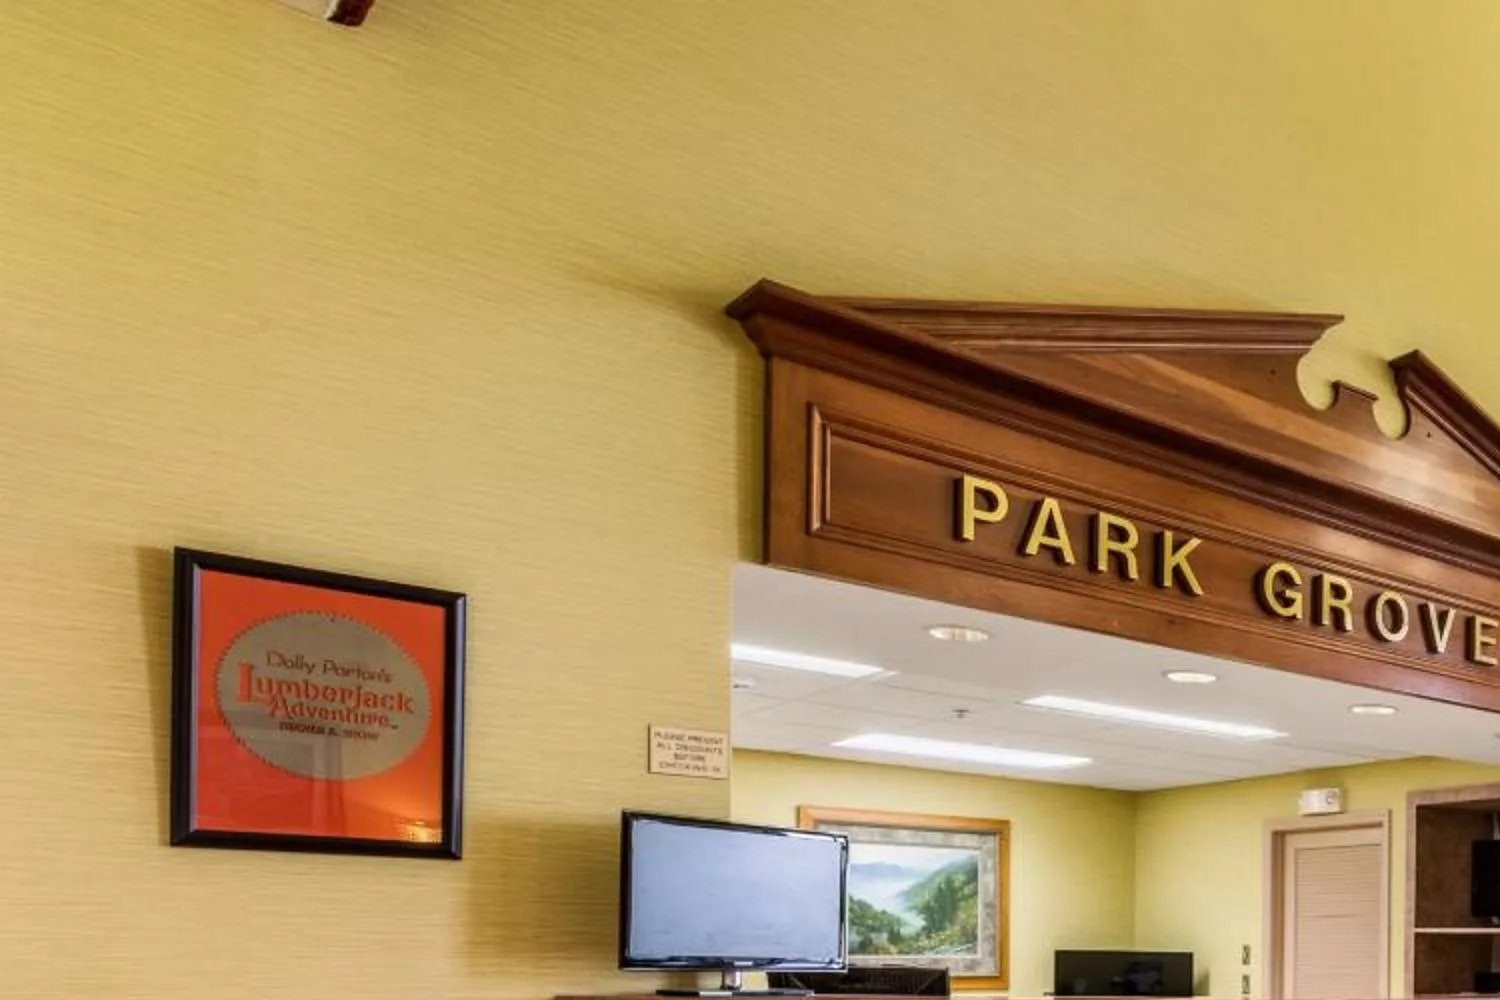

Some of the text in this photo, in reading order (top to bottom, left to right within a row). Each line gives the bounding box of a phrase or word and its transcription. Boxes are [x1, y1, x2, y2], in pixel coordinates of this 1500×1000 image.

[954, 473, 1204, 596] PARK
[1252, 562, 1499, 667] GROVE
[236, 661, 414, 714] Lumberjack
[266, 650, 393, 683] Dolly Parton's
[269, 694, 390, 728] Adventure
